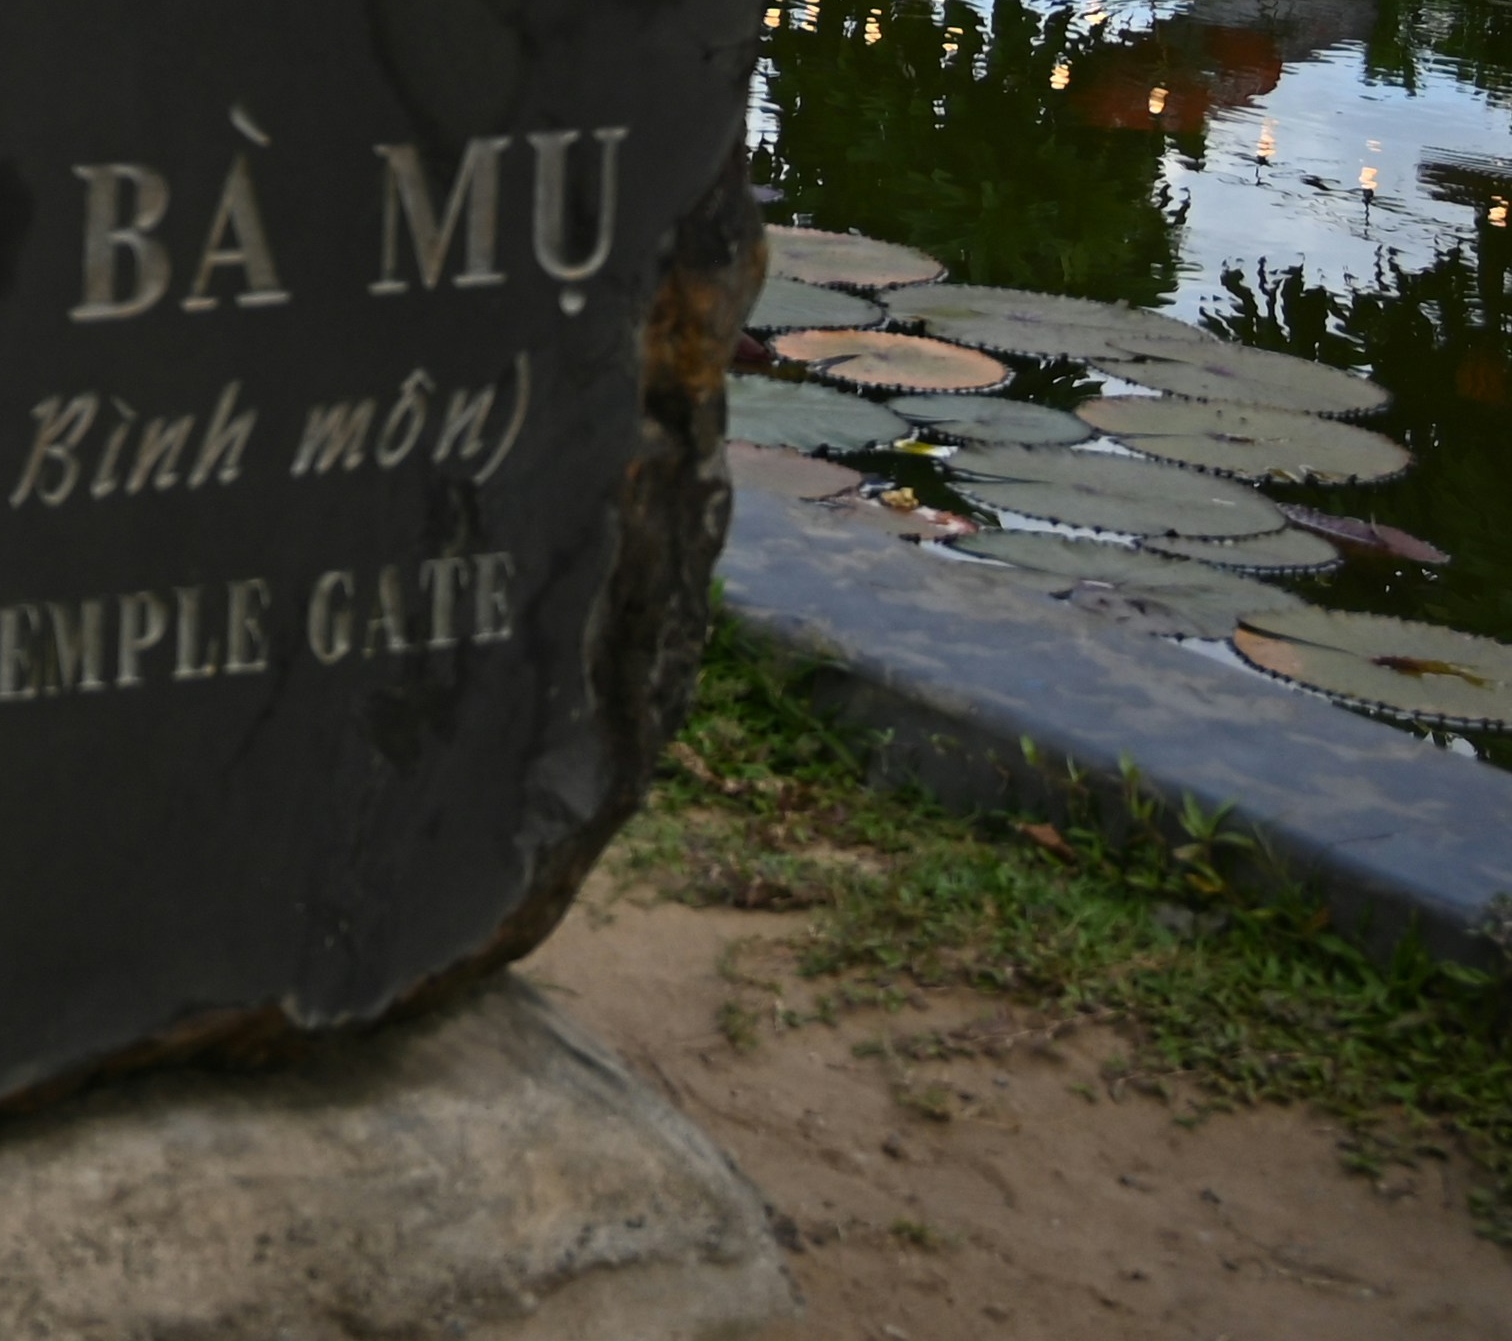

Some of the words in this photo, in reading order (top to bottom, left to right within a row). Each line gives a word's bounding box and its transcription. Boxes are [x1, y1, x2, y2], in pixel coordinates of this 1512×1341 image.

[67, 104, 292, 323] BÀ
[368, 125, 631, 316] MỤ
[9, 379, 258, 506] Bình
[288, 350, 531, 487] môn)
[305, 549, 517, 667] GATE
